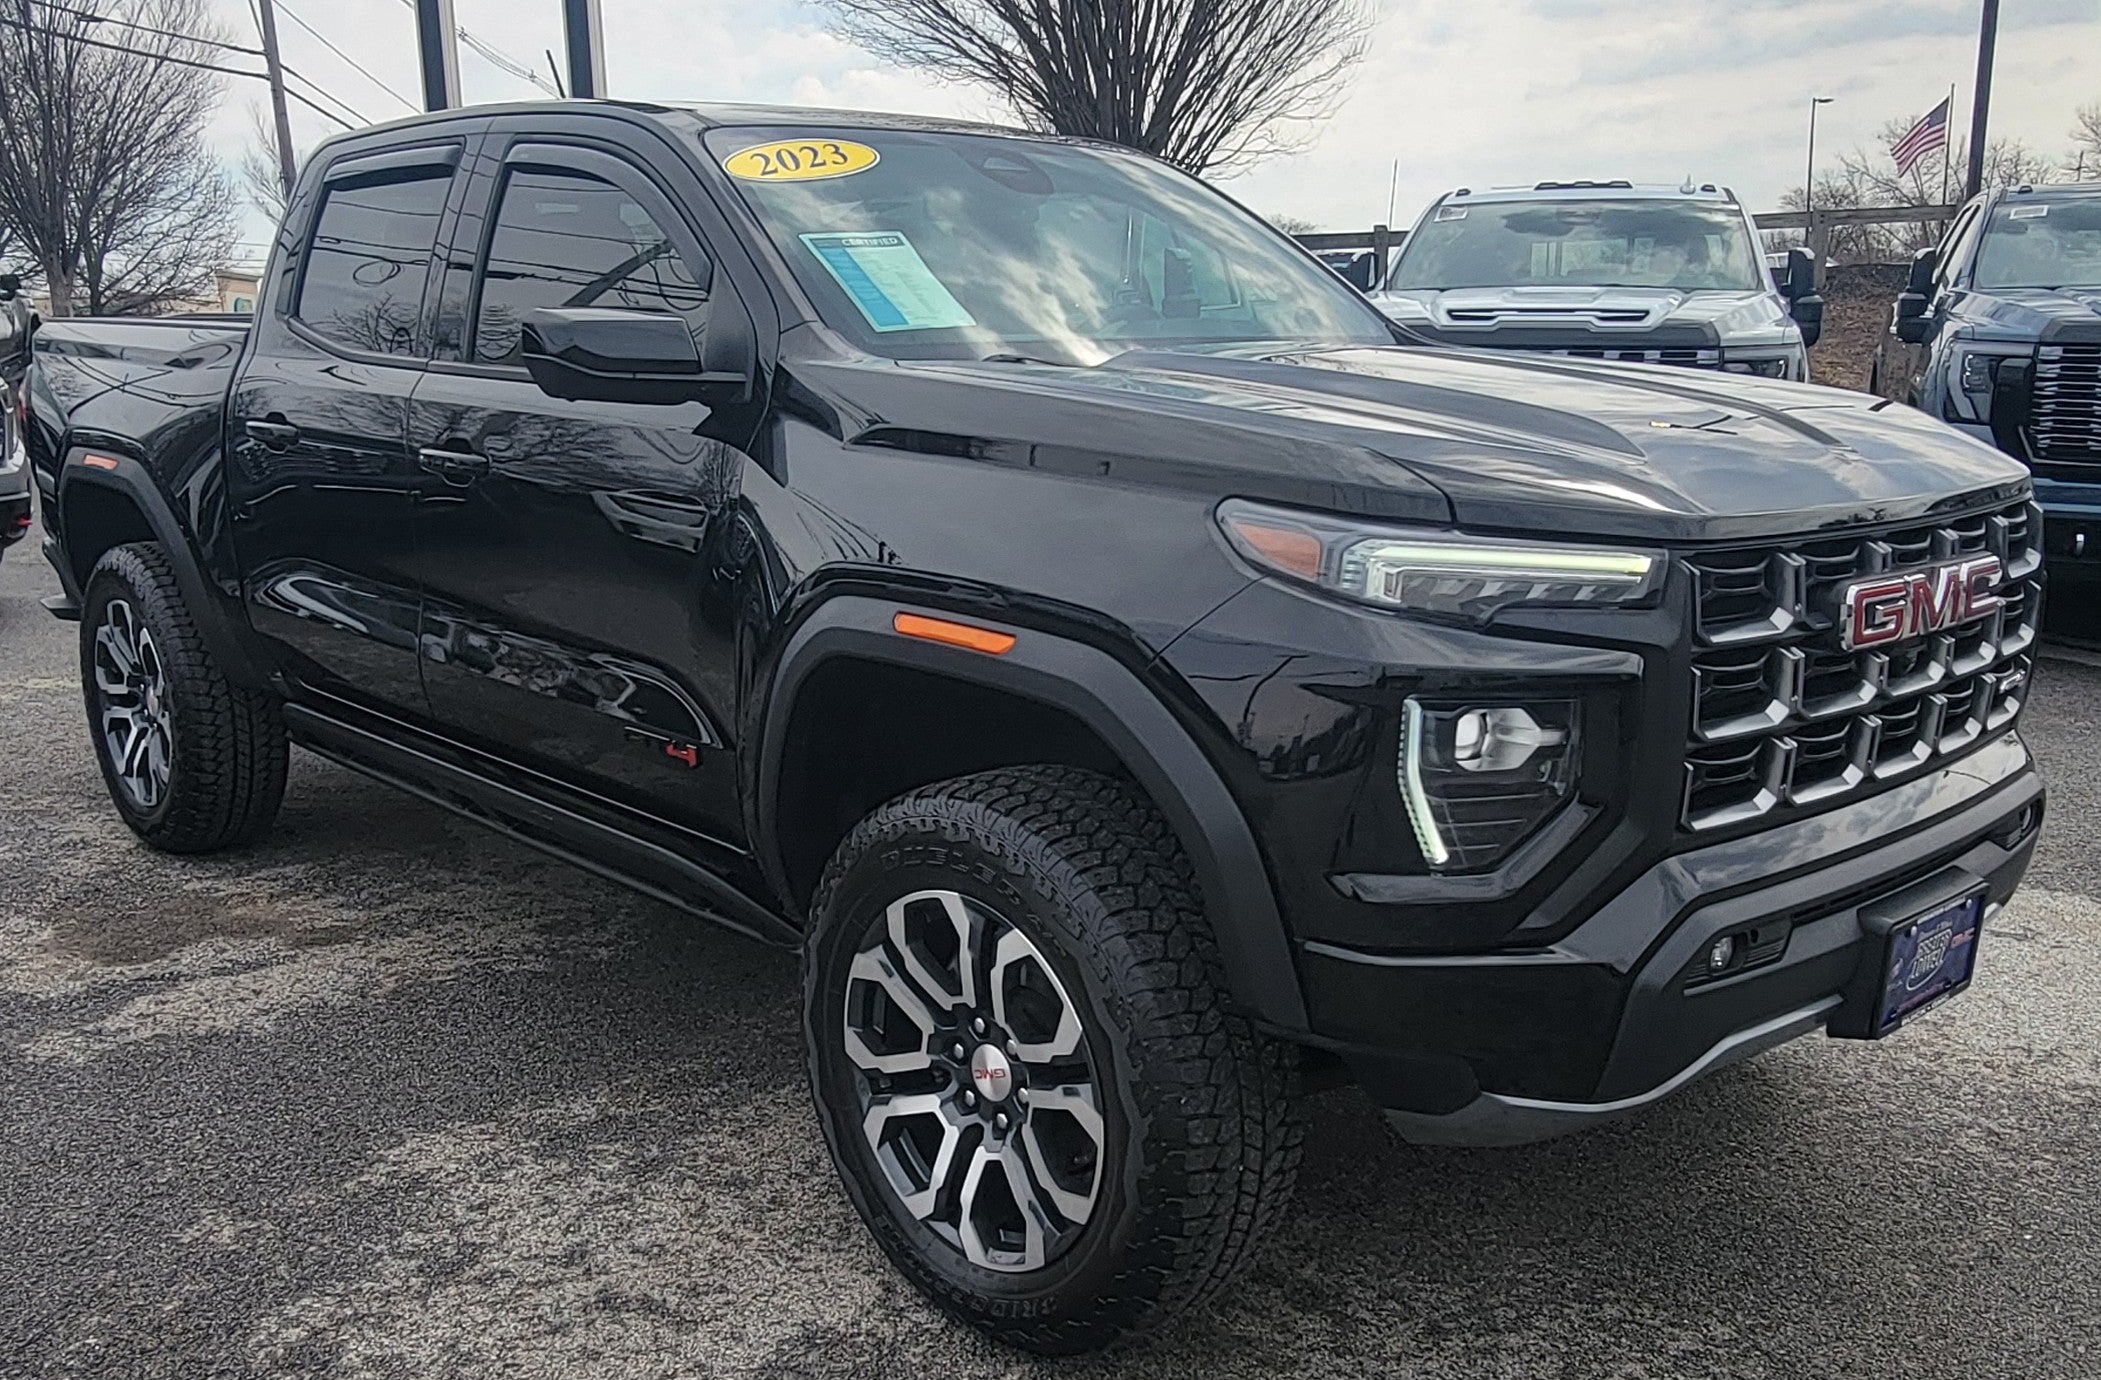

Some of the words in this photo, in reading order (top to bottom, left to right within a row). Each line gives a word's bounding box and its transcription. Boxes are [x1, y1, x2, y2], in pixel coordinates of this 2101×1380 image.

[750, 143, 849, 177] 2023
[842, 237, 898, 247] CERTIFIED
[1846, 555, 2003, 651] GMC
[880, 847, 1021, 905] DUELER
[974, 1068, 1006, 1079] GMC
